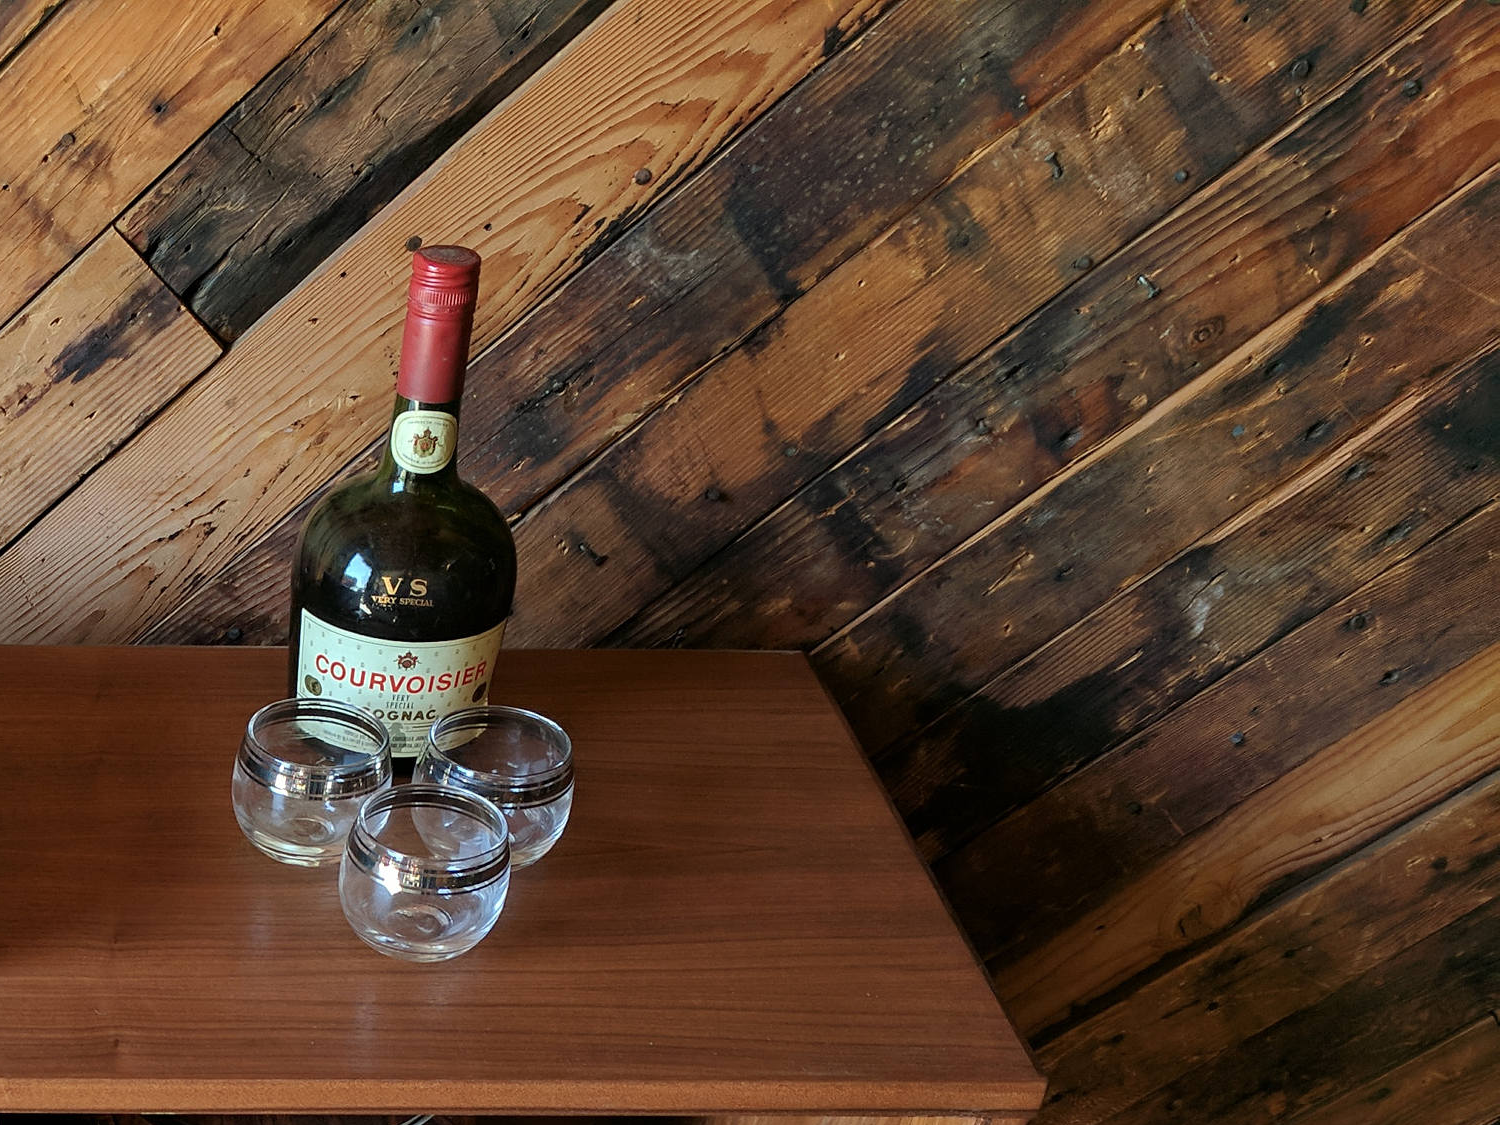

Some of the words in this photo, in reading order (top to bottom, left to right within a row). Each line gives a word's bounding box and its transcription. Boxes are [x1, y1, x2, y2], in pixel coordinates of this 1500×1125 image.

[382, 576, 403, 595] V
[410, 578, 428, 597] S
[371, 595, 397, 605] VERY
[399, 597, 434, 607] SPECIAL
[315, 654, 487, 694] COURVOISIER
[392, 694, 411, 702] VERY
[385, 702, 415, 710] SPECIAL
